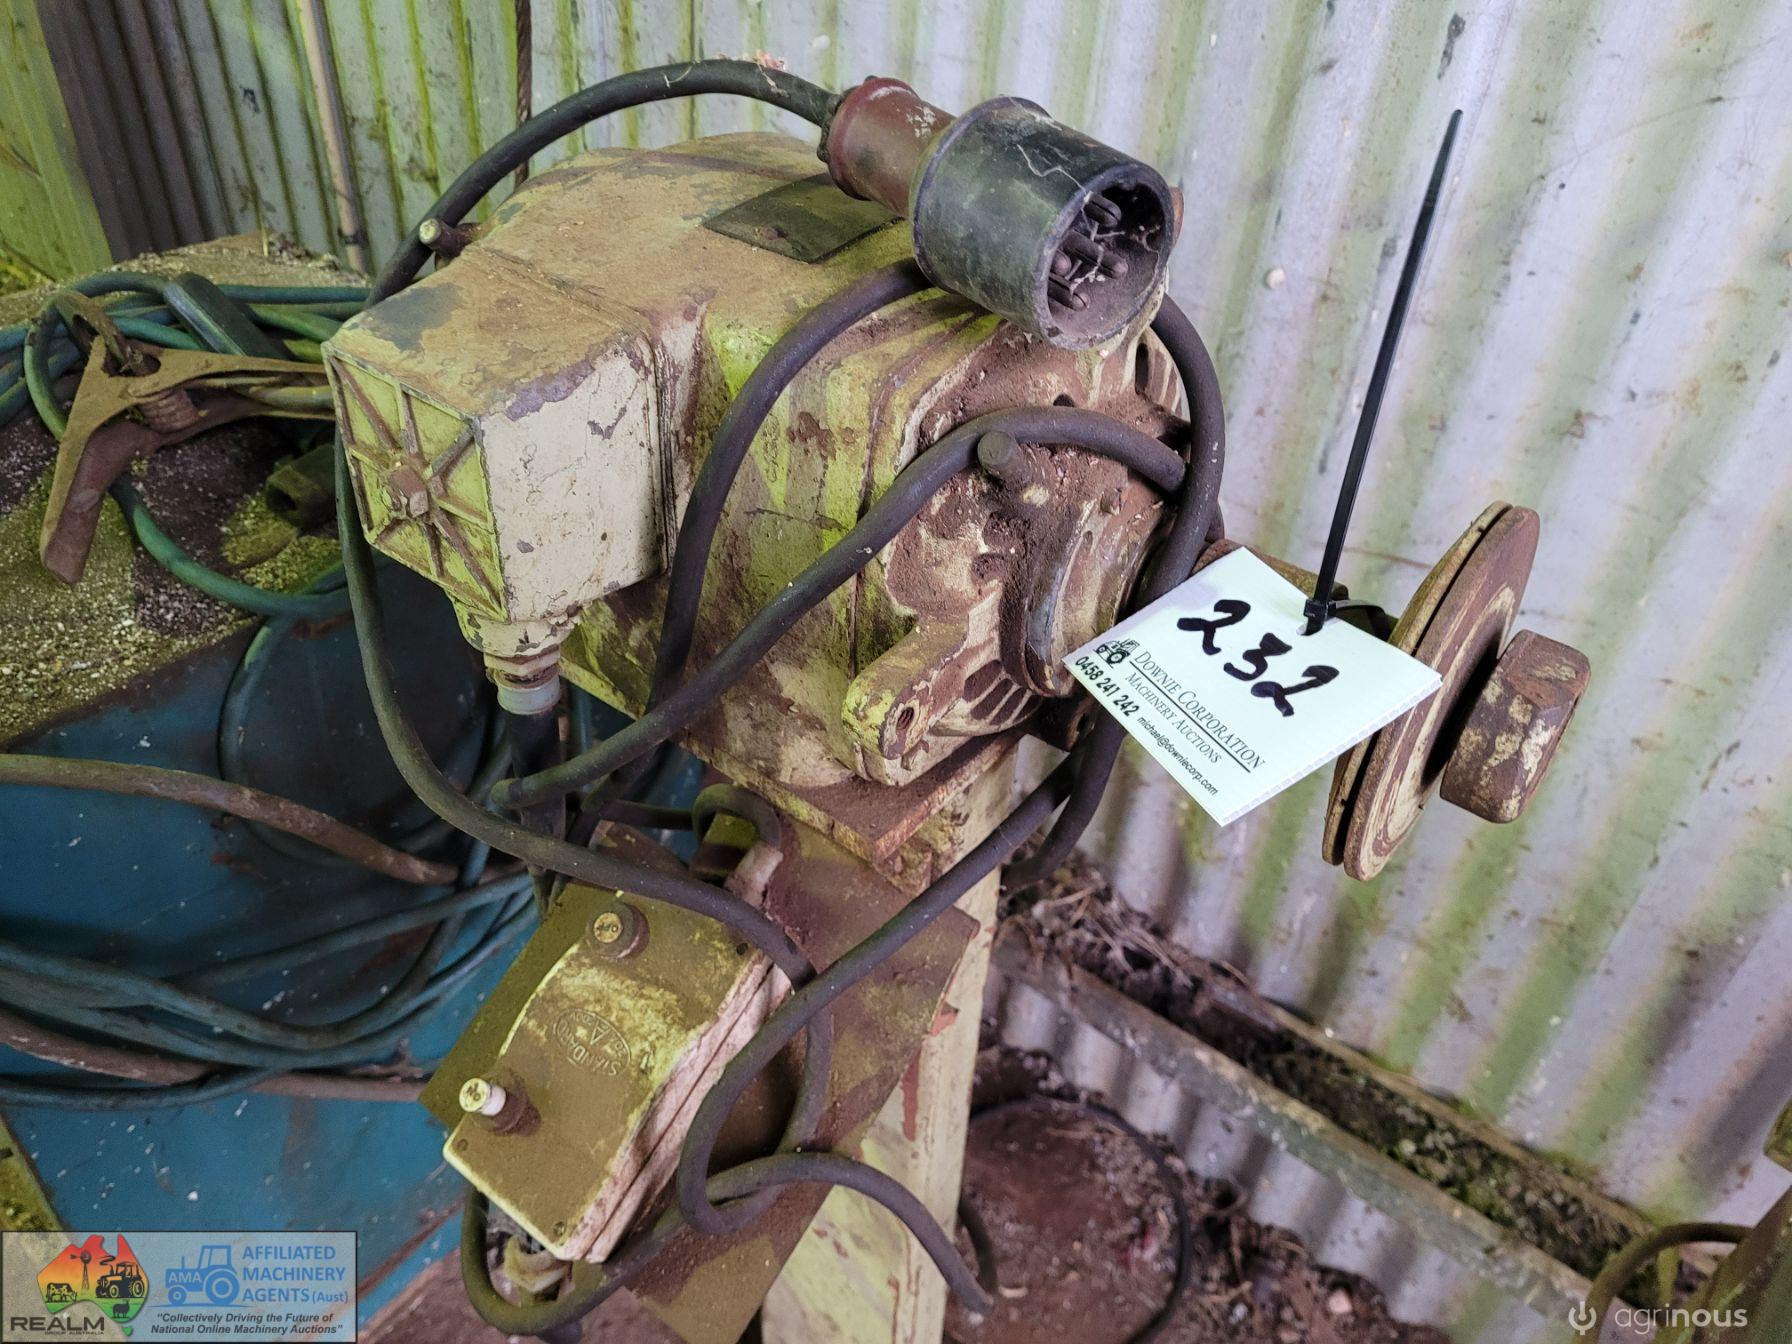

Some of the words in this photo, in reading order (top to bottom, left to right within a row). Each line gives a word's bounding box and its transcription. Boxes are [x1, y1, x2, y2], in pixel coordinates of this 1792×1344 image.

[1075, 656, 1102, 681] 0458
[1096, 677, 1121, 698] 241
[1113, 694, 1140, 717] 242
[1176, 599, 1340, 718] 232
[1125, 672, 1178, 721] MACHINERY
[1172, 719, 1222, 765] AUCTIONS
[1134, 651, 1181, 696] DOWNIE
[1178, 690, 1266, 770] CORPORATION
[1137, 716, 1219, 795] michael@downiecorp.com
[557, 1018, 622, 1076] STANDARD
